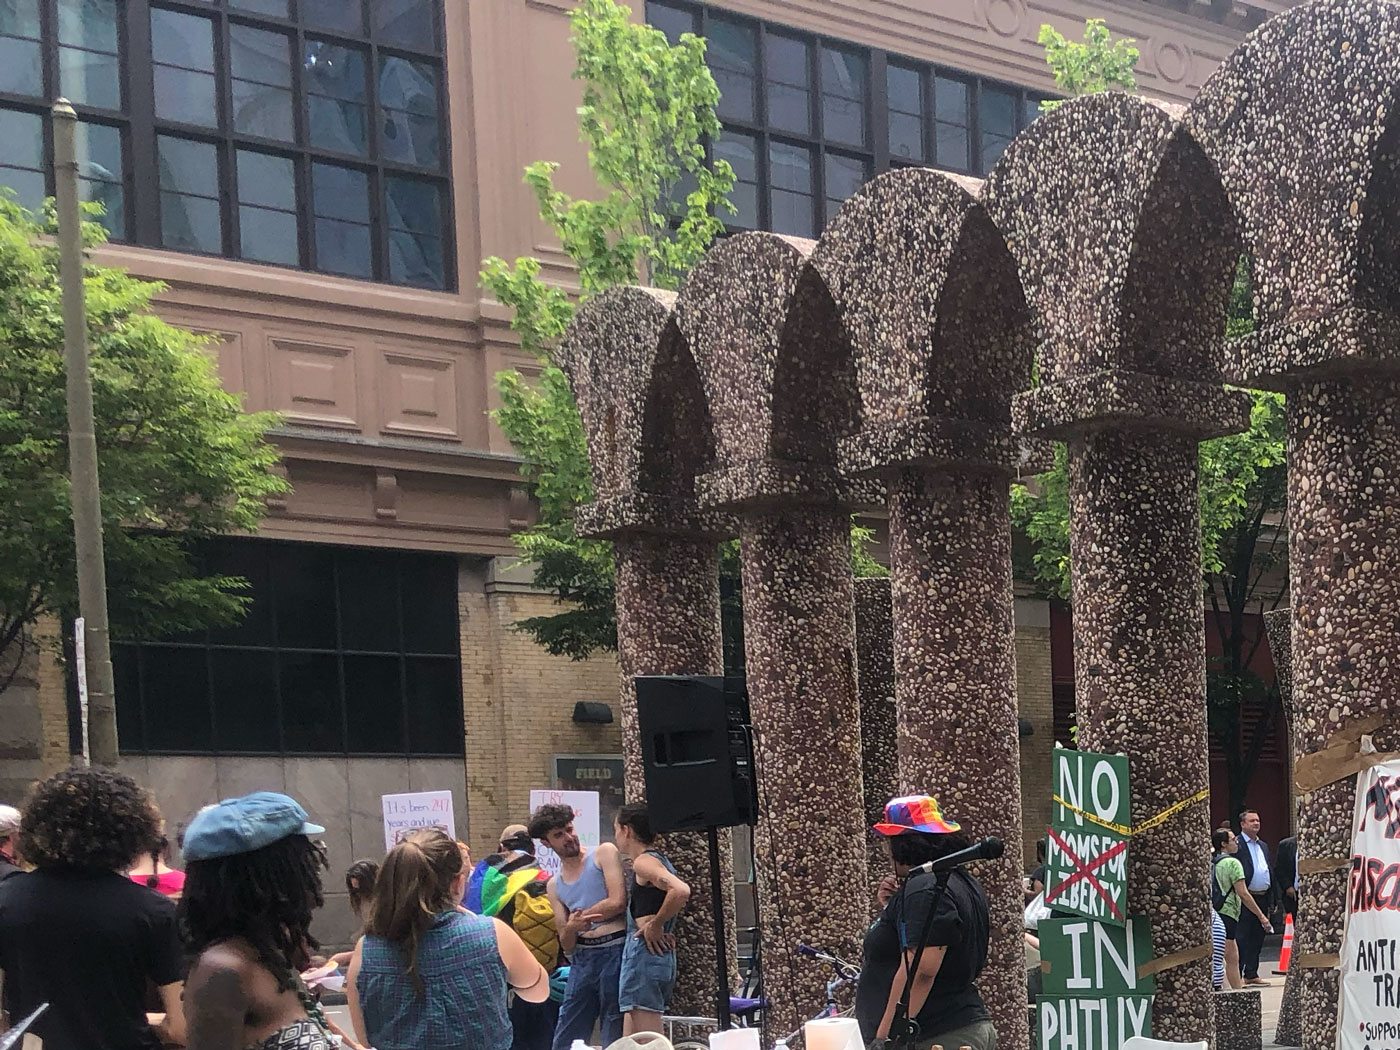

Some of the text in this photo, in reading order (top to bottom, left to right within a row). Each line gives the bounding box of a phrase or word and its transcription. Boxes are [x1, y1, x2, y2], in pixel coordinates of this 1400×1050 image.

[1059, 755, 1120, 826] NO
[1049, 832, 1128, 882] MOMS FOR
[1045, 869, 1122, 920] LIBERTY
[1062, 919, 1137, 990] IN
